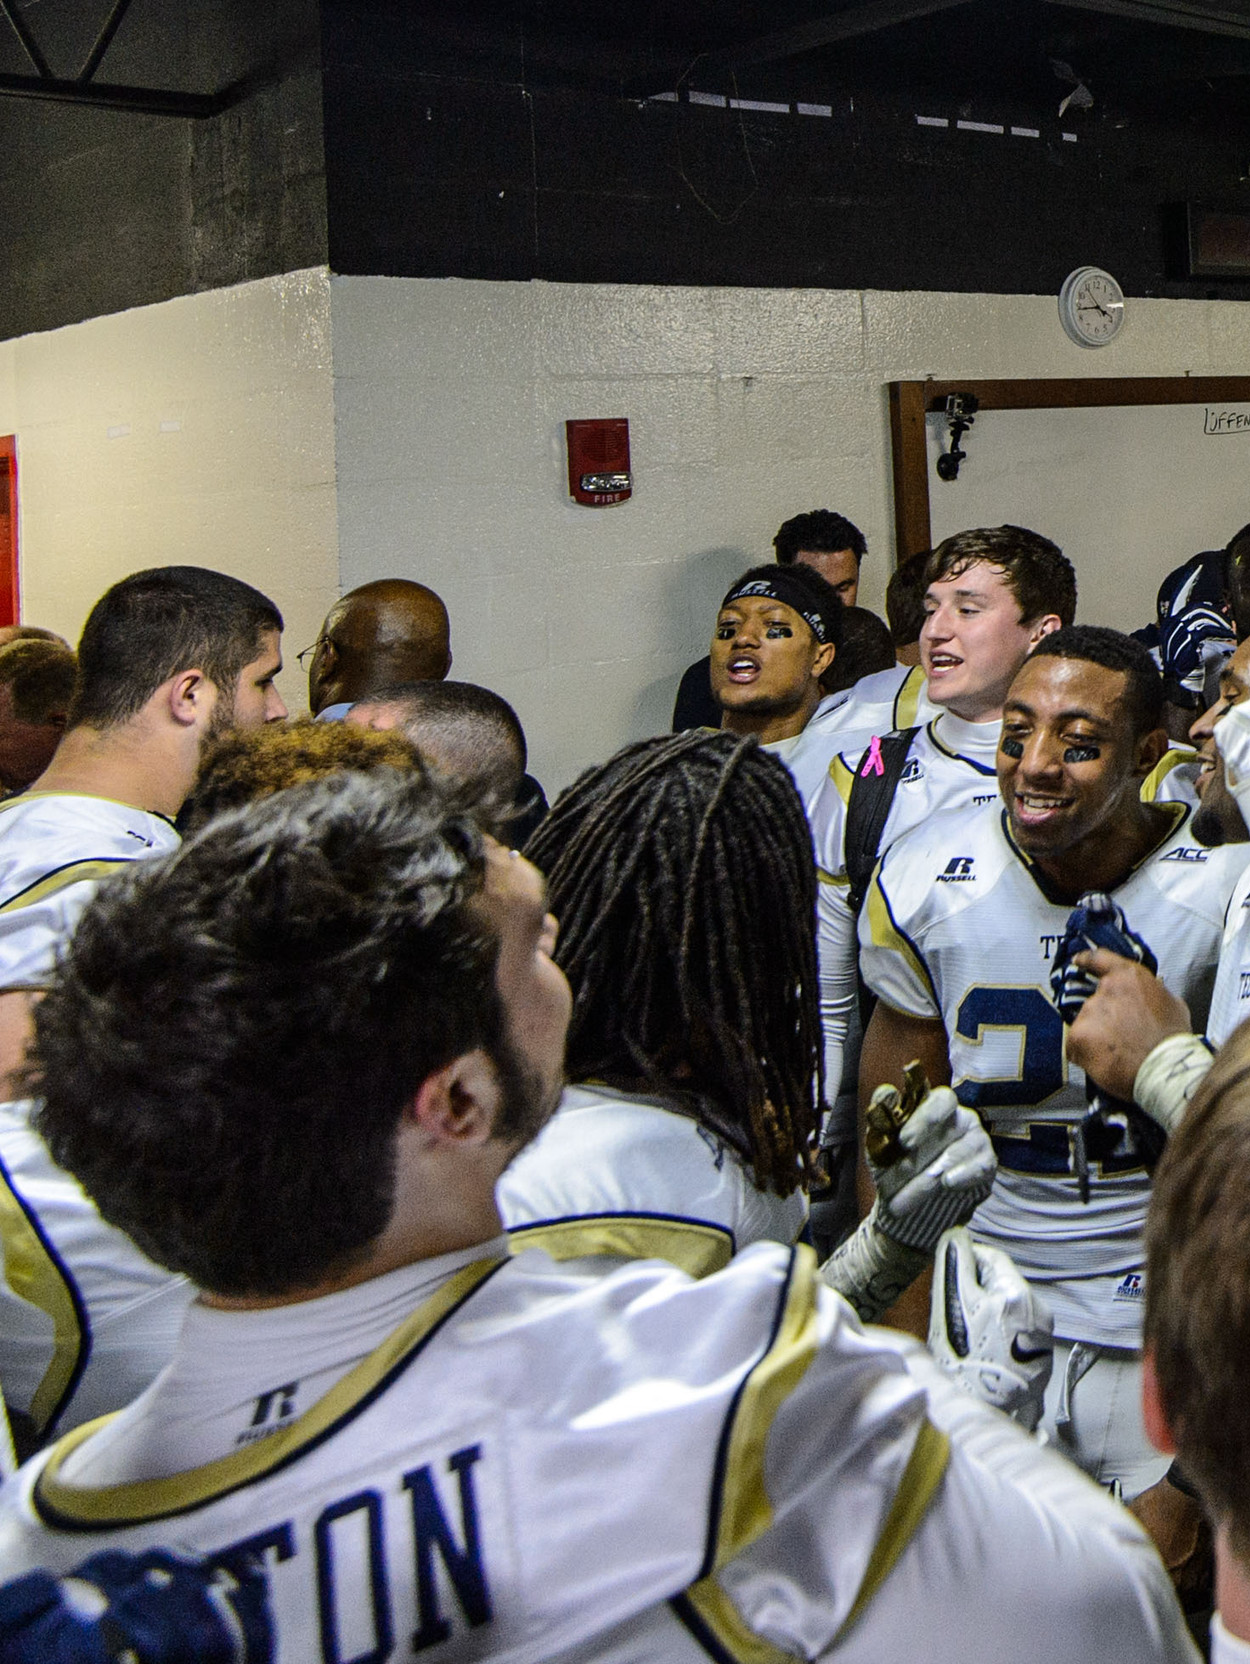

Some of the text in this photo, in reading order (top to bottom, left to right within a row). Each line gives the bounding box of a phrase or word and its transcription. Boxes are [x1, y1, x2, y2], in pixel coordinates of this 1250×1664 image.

[594, 493, 620, 503] FIRE
[1159, 846, 1213, 862] ACC
[935, 874, 977, 883] RUSSELL
